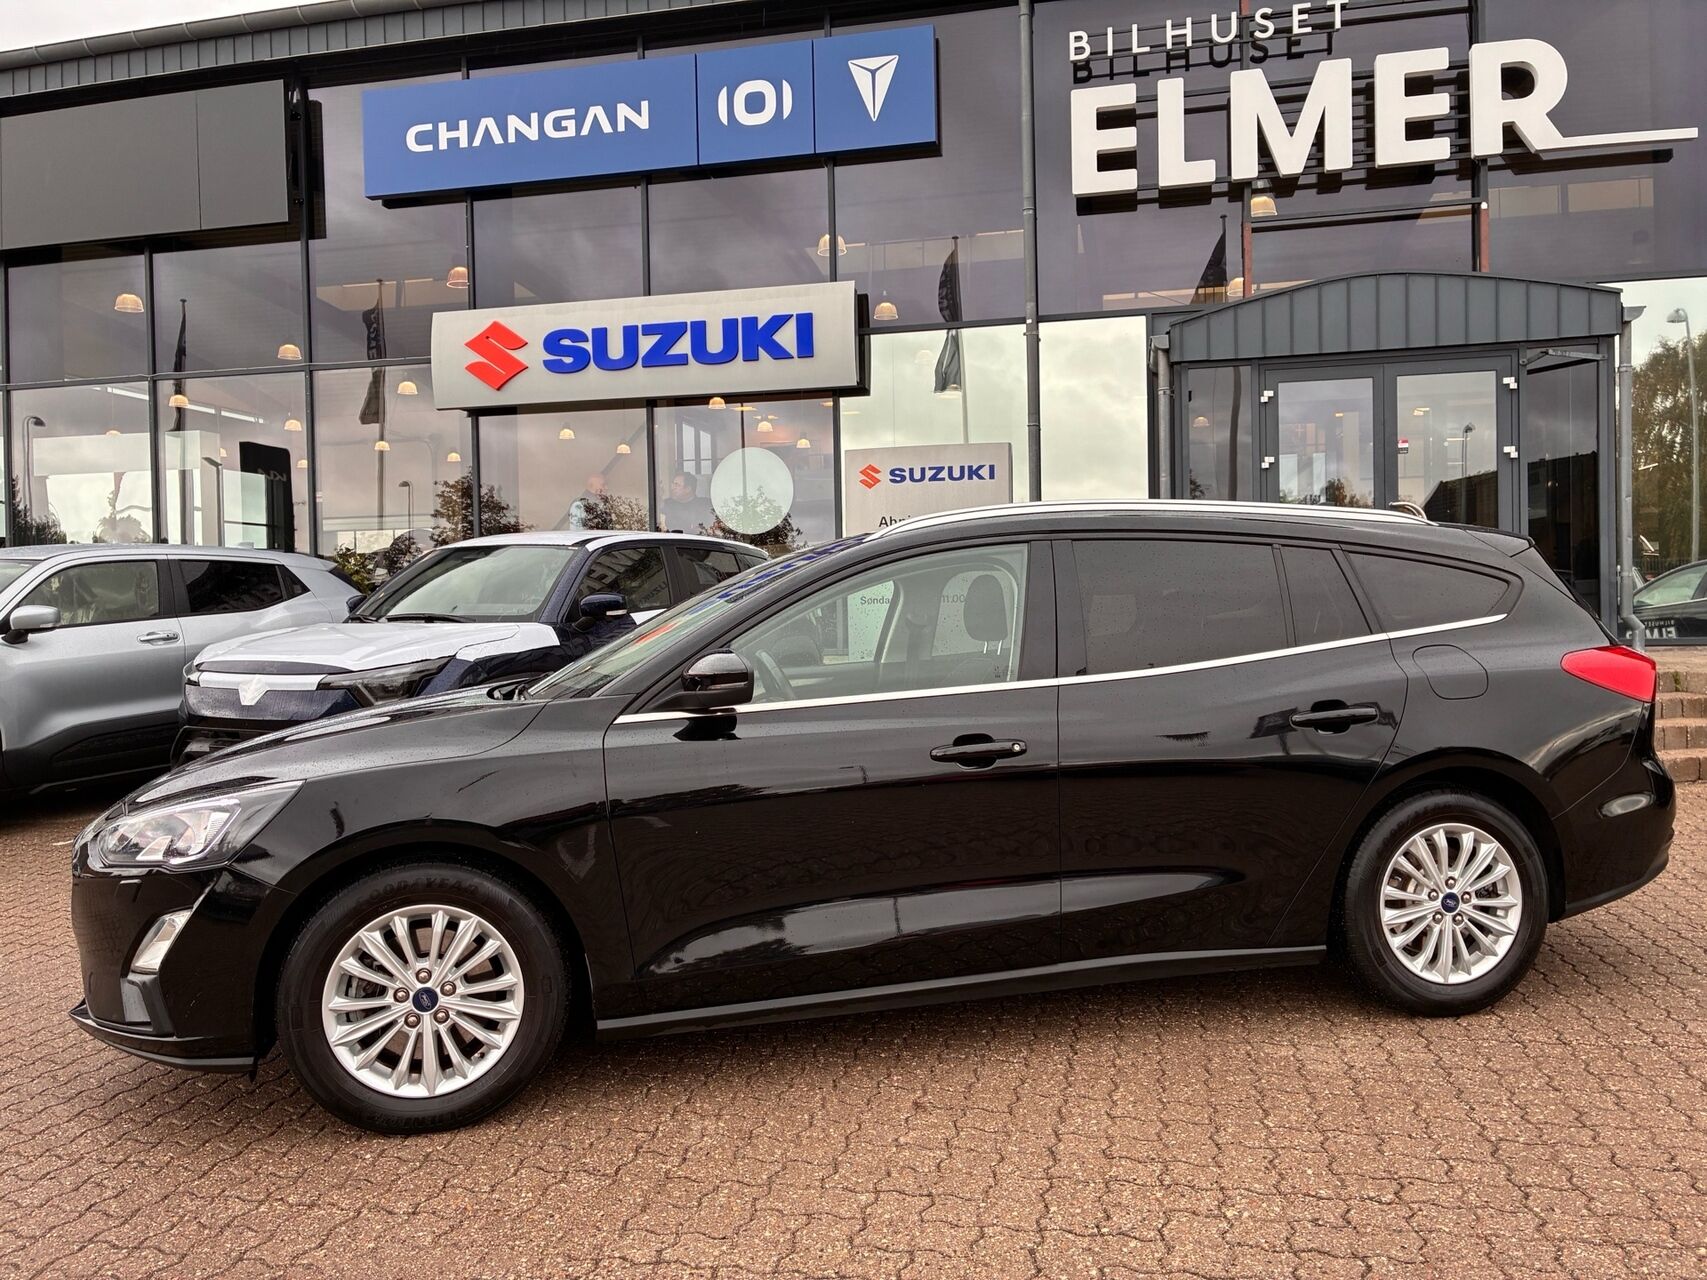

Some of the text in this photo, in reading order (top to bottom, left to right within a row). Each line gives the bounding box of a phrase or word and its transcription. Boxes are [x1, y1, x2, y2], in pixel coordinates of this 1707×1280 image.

[1068, 0, 1349, 62] BILHUSET
[405, 99, 650, 153] CHANGAN
[1070, 38, 1699, 197] ELMER
[542, 311, 815, 375] SUZUKI
[888, 464, 996, 484] SUZUKI
[860, 595, 890, 605] Sønda
